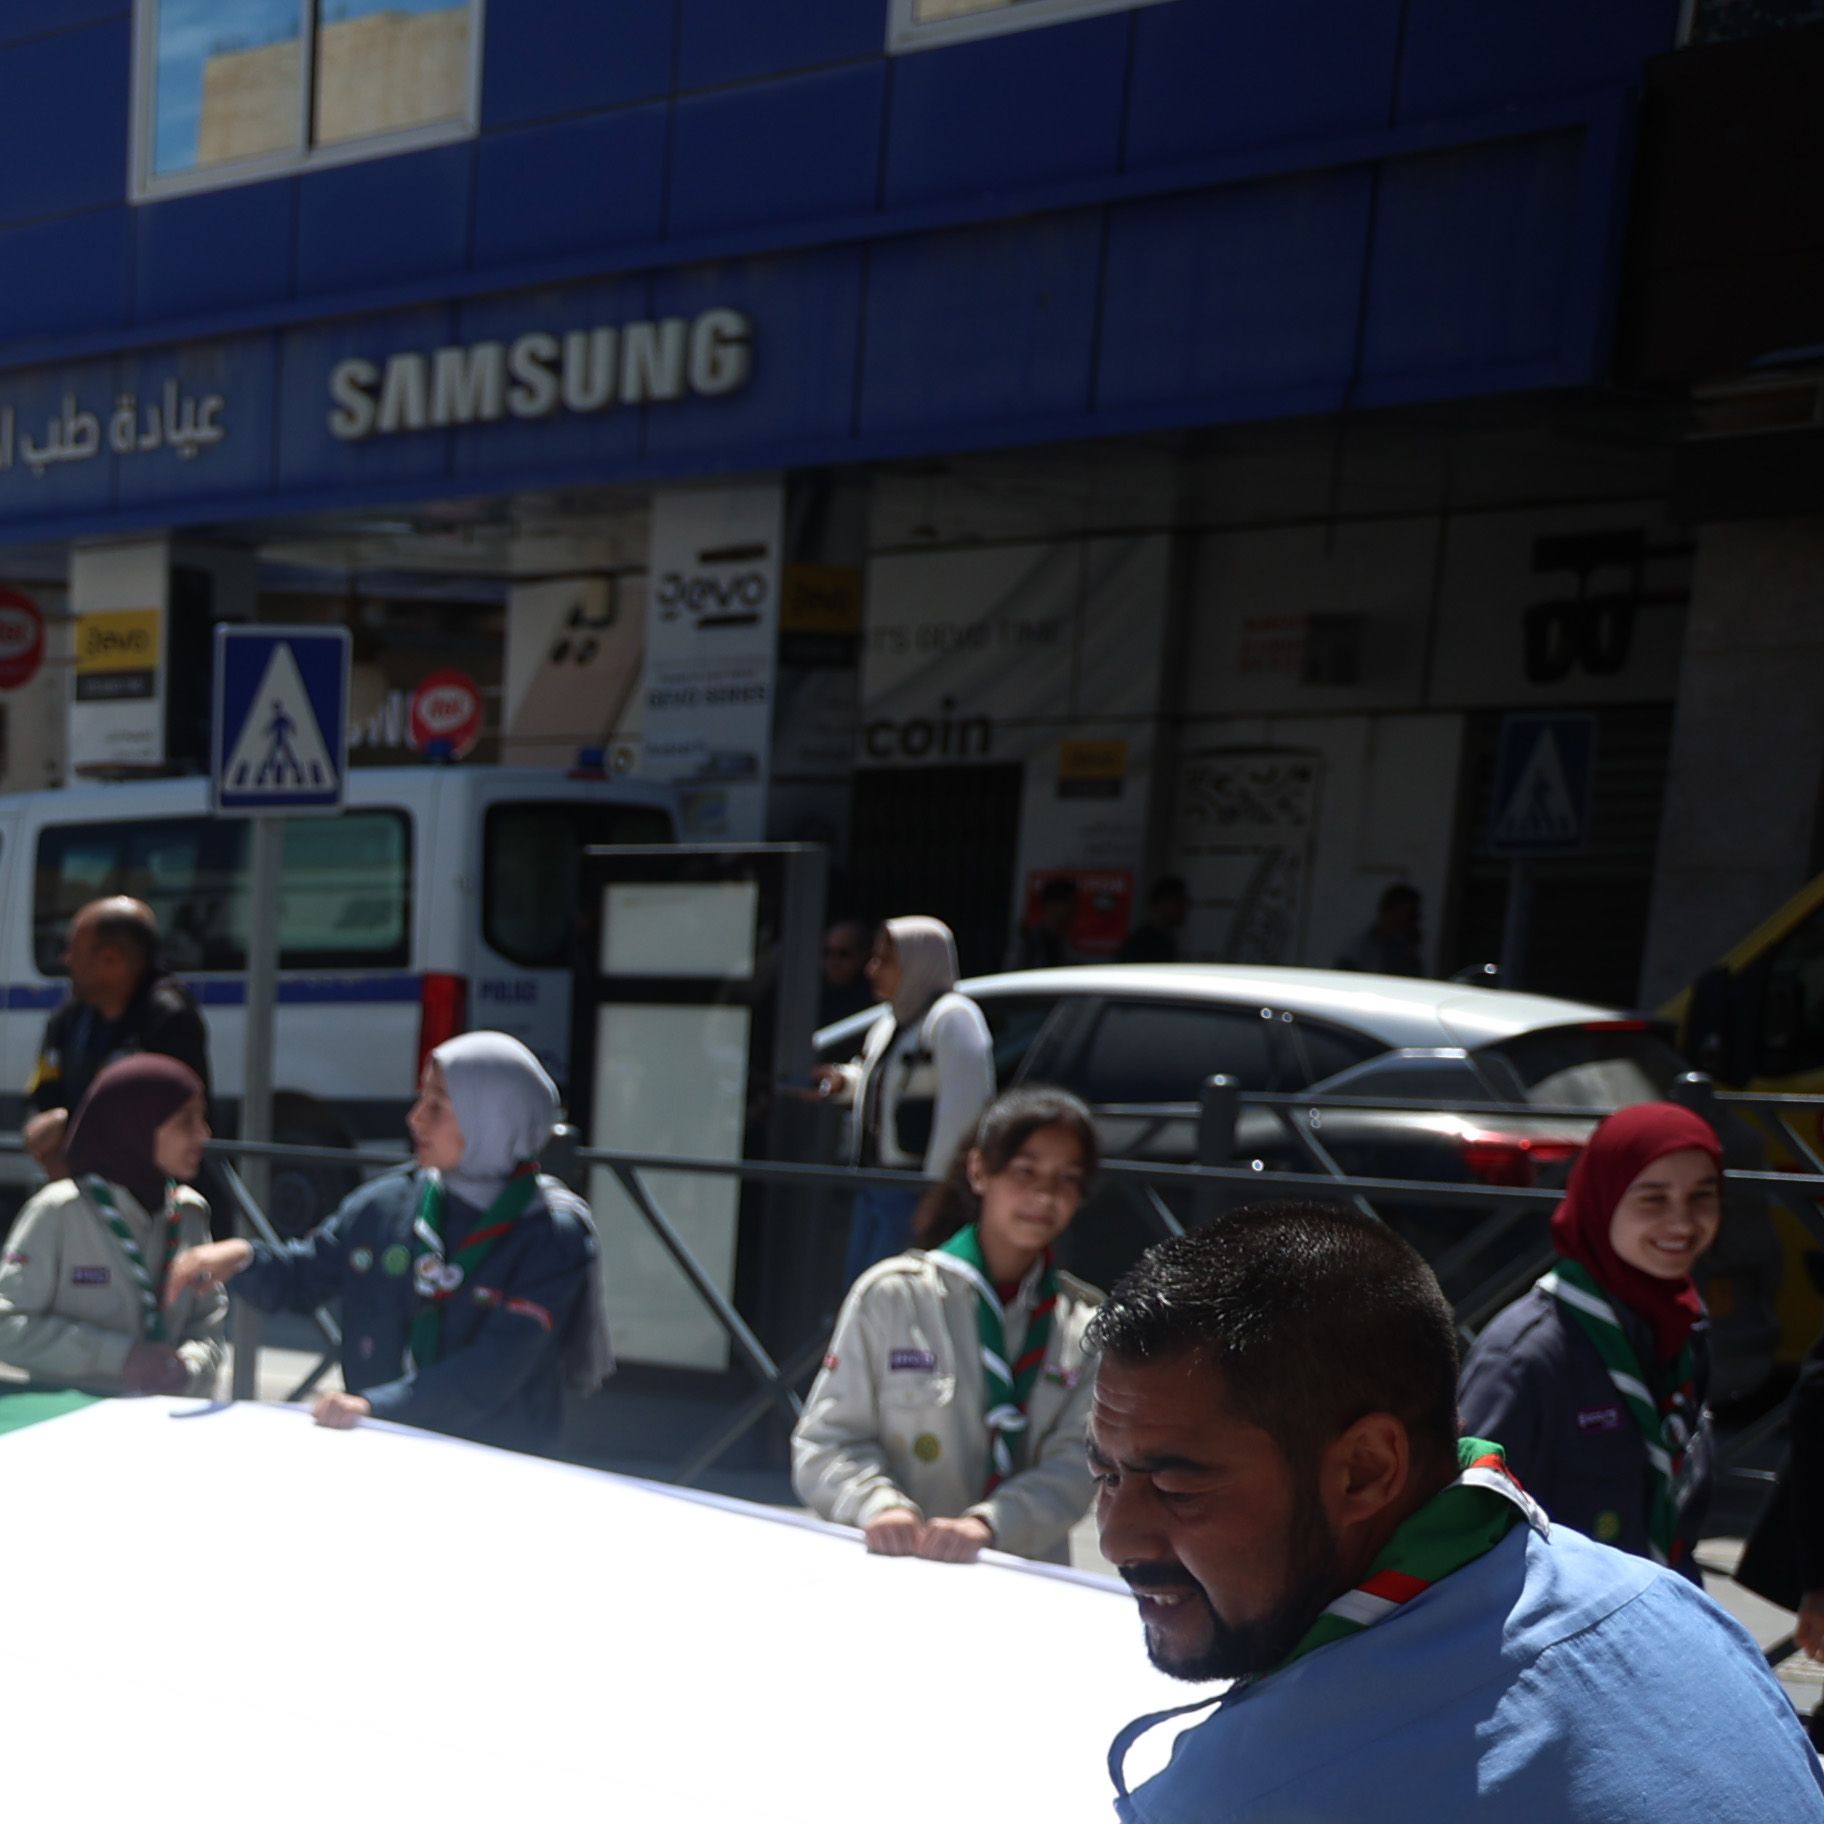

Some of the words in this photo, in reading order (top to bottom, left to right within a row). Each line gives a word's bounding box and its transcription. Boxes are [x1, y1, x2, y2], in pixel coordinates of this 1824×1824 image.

[329, 309, 751, 441] SAMSUNG
[20, 390, 100, 478] طب
[110, 377, 226, 460] عيادة
[864, 694, 991, 758] coin
